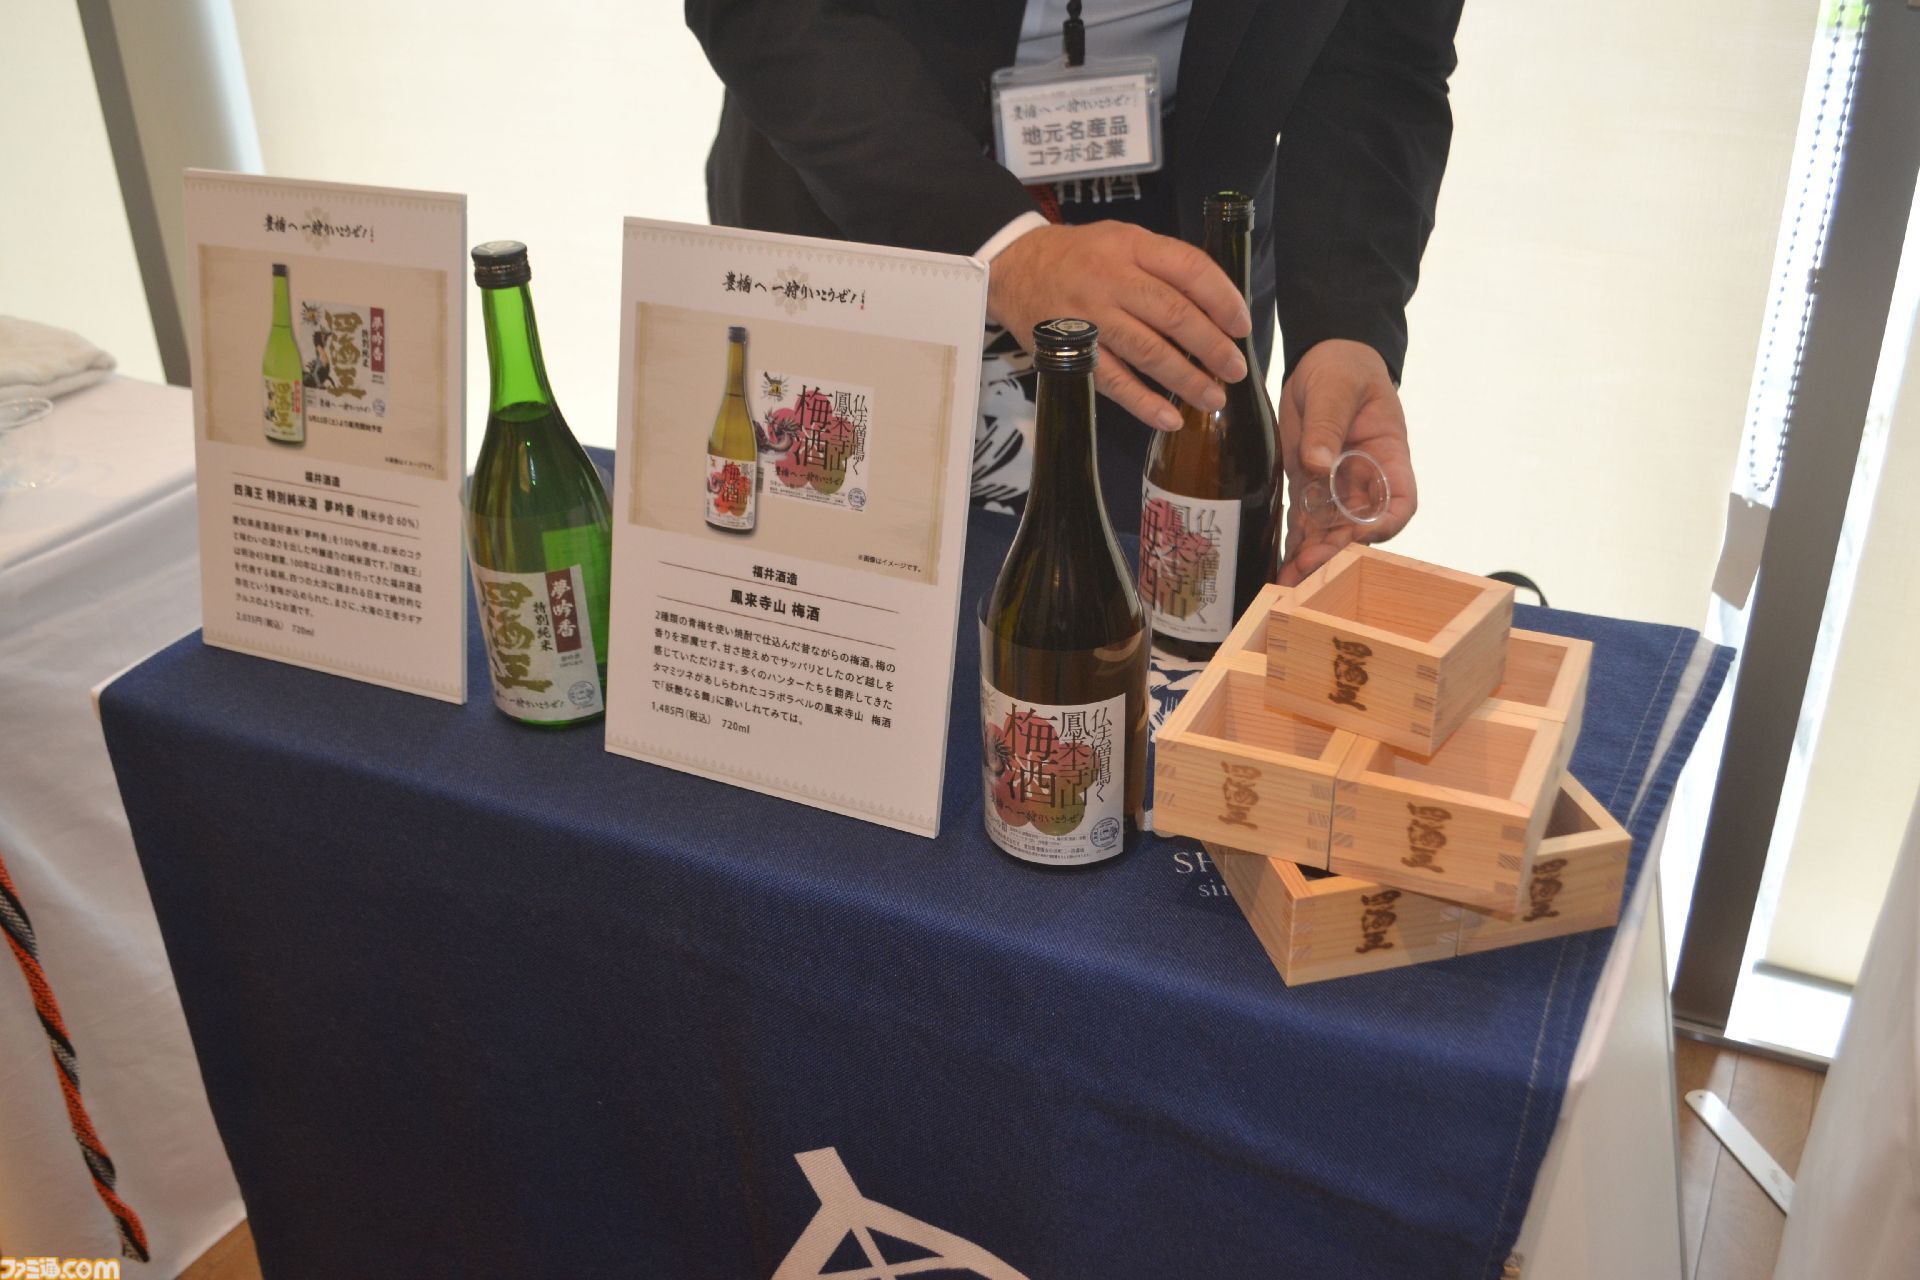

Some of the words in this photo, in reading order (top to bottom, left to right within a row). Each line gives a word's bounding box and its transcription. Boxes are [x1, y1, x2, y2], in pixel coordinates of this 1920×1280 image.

[1022, 115, 1128, 145] 地元名産品
[1028, 138, 1126, 166] コラボ企業
[324, 309, 367, 400] 四海王
[794, 384, 834, 470] 梅酒
[234, 483, 263, 501] 四海王
[267, 489, 318, 511] 特別純米酒
[324, 499, 354, 518] 夢吟香
[305, 471, 341, 487] 福井酒造
[752, 565, 798, 587] 福井酒造
[858, 554, 921, 573] ※画像はイメージです。
[533, 601, 554, 652] 特別純米
[550, 579, 577, 638] 夢吟香
[730, 589, 786, 615] 鳳来寺山
[791, 602, 821, 622] 梅酒
[654, 627, 894, 692] 香りを邪魔せず、甘さ控えめでサッパリとしたのど越しを
[655, 610, 896, 673] 2種類の青梅を使い焼酎で仕込んだ昔ながらの梅酒。梅の
[653, 644, 893, 711] 感じていただけます。多くのハンターたちを翻弄してきた
[651, 701, 711, 725] 1,485円（税込）
[722, 718, 751, 734] 720ml
[652, 679, 803, 726] で「妖艶なる舞」に酔いしれてみては。
[1004, 703, 1060, 808] 梅酒
